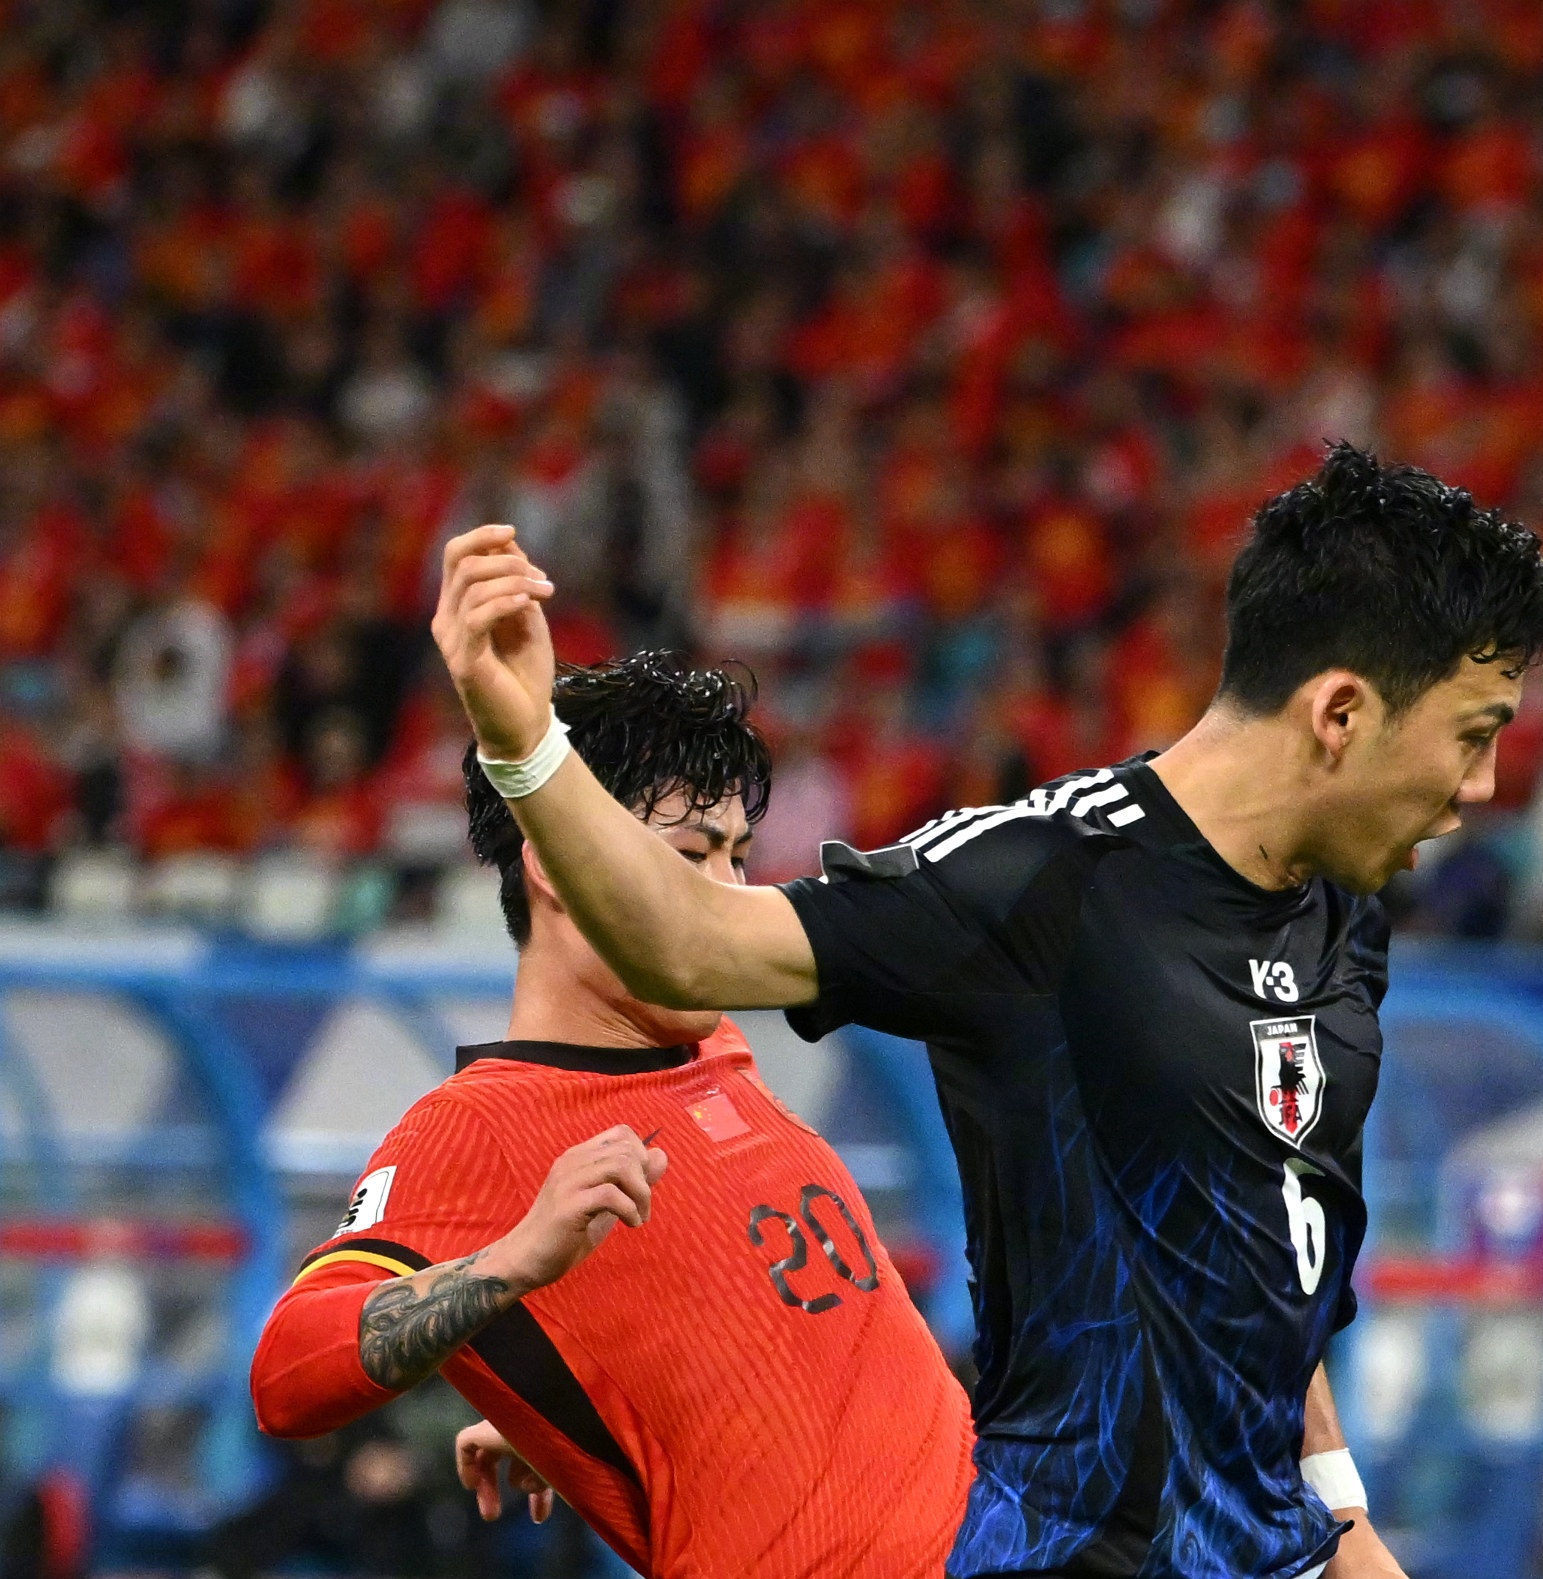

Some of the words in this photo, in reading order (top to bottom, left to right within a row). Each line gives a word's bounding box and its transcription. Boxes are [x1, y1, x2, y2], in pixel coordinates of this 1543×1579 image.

[1248, 959, 1299, 1003] Y-3
[1266, 1023, 1298, 1036] JAPAN
[748, 1183, 879, 1315] 20
[1282, 1157, 1326, 1296] 6
